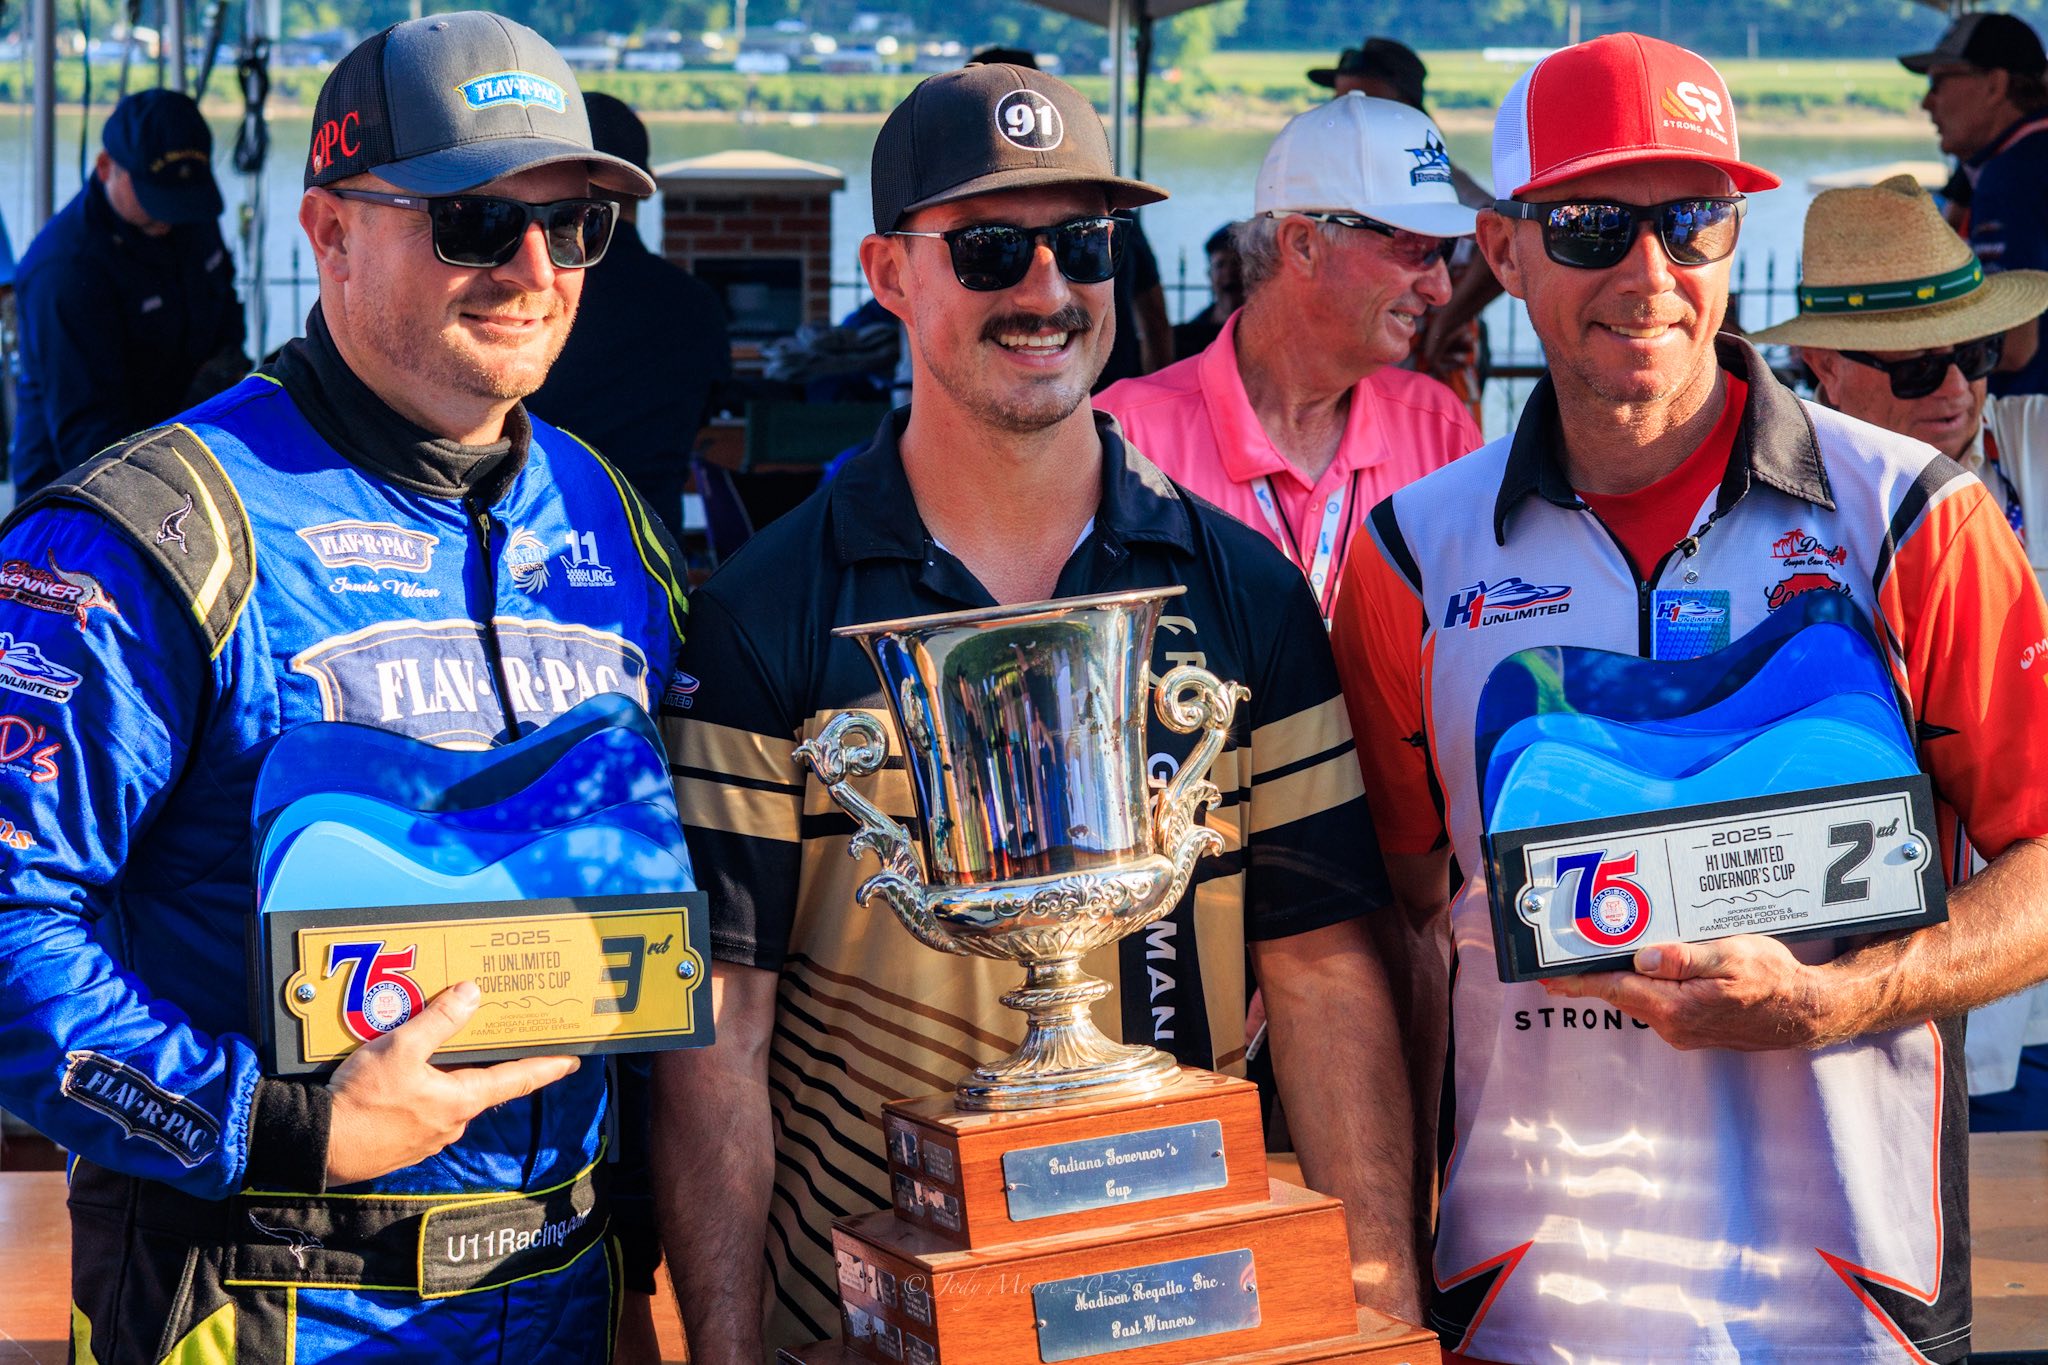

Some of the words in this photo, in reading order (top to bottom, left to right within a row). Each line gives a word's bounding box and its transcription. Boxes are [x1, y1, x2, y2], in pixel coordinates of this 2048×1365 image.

[1005, 103, 1053, 137] 91
[1663, 119, 1703, 134] STRONG
[565, 529, 600, 566] 11
[328, 577, 380, 594] Jamie
[382, 580, 441, 598] Nilsen
[1443, 589, 1485, 629] H1
[1482, 603, 1570, 626] UNLIMITED
[1712, 826, 1772, 846] 2025
[1706, 854, 1719, 872] H1
[1721, 845, 1784, 869] UNLIMITED
[1699, 867, 1770, 892] GOVERNOR'S
[1773, 863, 1796, 882] CUP
[1553, 849, 1652, 948] 75
[1593, 888, 1634, 907] MADISON
[1713, 913, 1753, 924] MORGAN
[1755, 909, 1786, 918] FOODS
[1728, 906, 1767, 915] SPONSORED
[1595, 917, 1635, 933] REGATTA
[1699, 923, 1731, 933] FAMILY
[1733, 920, 1746, 928] OF
[1747, 916, 1777, 926] BUDDY
[1779, 911, 1809, 921] BYERS
[491, 930, 551, 947] 2025
[483, 955, 496, 973] H1
[499, 951, 561, 972] UNLIMITED
[327, 940, 425, 1042] 75
[365, 983, 409, 1002] MADISON
[475, 972, 546, 994] GOVERNOR'S
[548, 971, 571, 989] CUP
[368, 1012, 410, 1031] REGATTA
[485, 1020, 525, 1029] MORGAN
[527, 1018, 558, 1026] FOODS
[500, 1013, 540, 1021] SPONSORED
[471, 1028, 502, 1036] FAMILY
[519, 1025, 549, 1033] BUDDY
[551, 1022, 581, 1031] BYERS
[1049, 1156, 1104, 1175] Indiana
[1105, 1179, 1132, 1200] Cup
[1075, 1291, 1130, 1311] Madison
[1132, 1279, 1185, 1303] Regatta
[1111, 1319, 1142, 1339] Past
[1144, 1314, 1196, 1333] Winners
